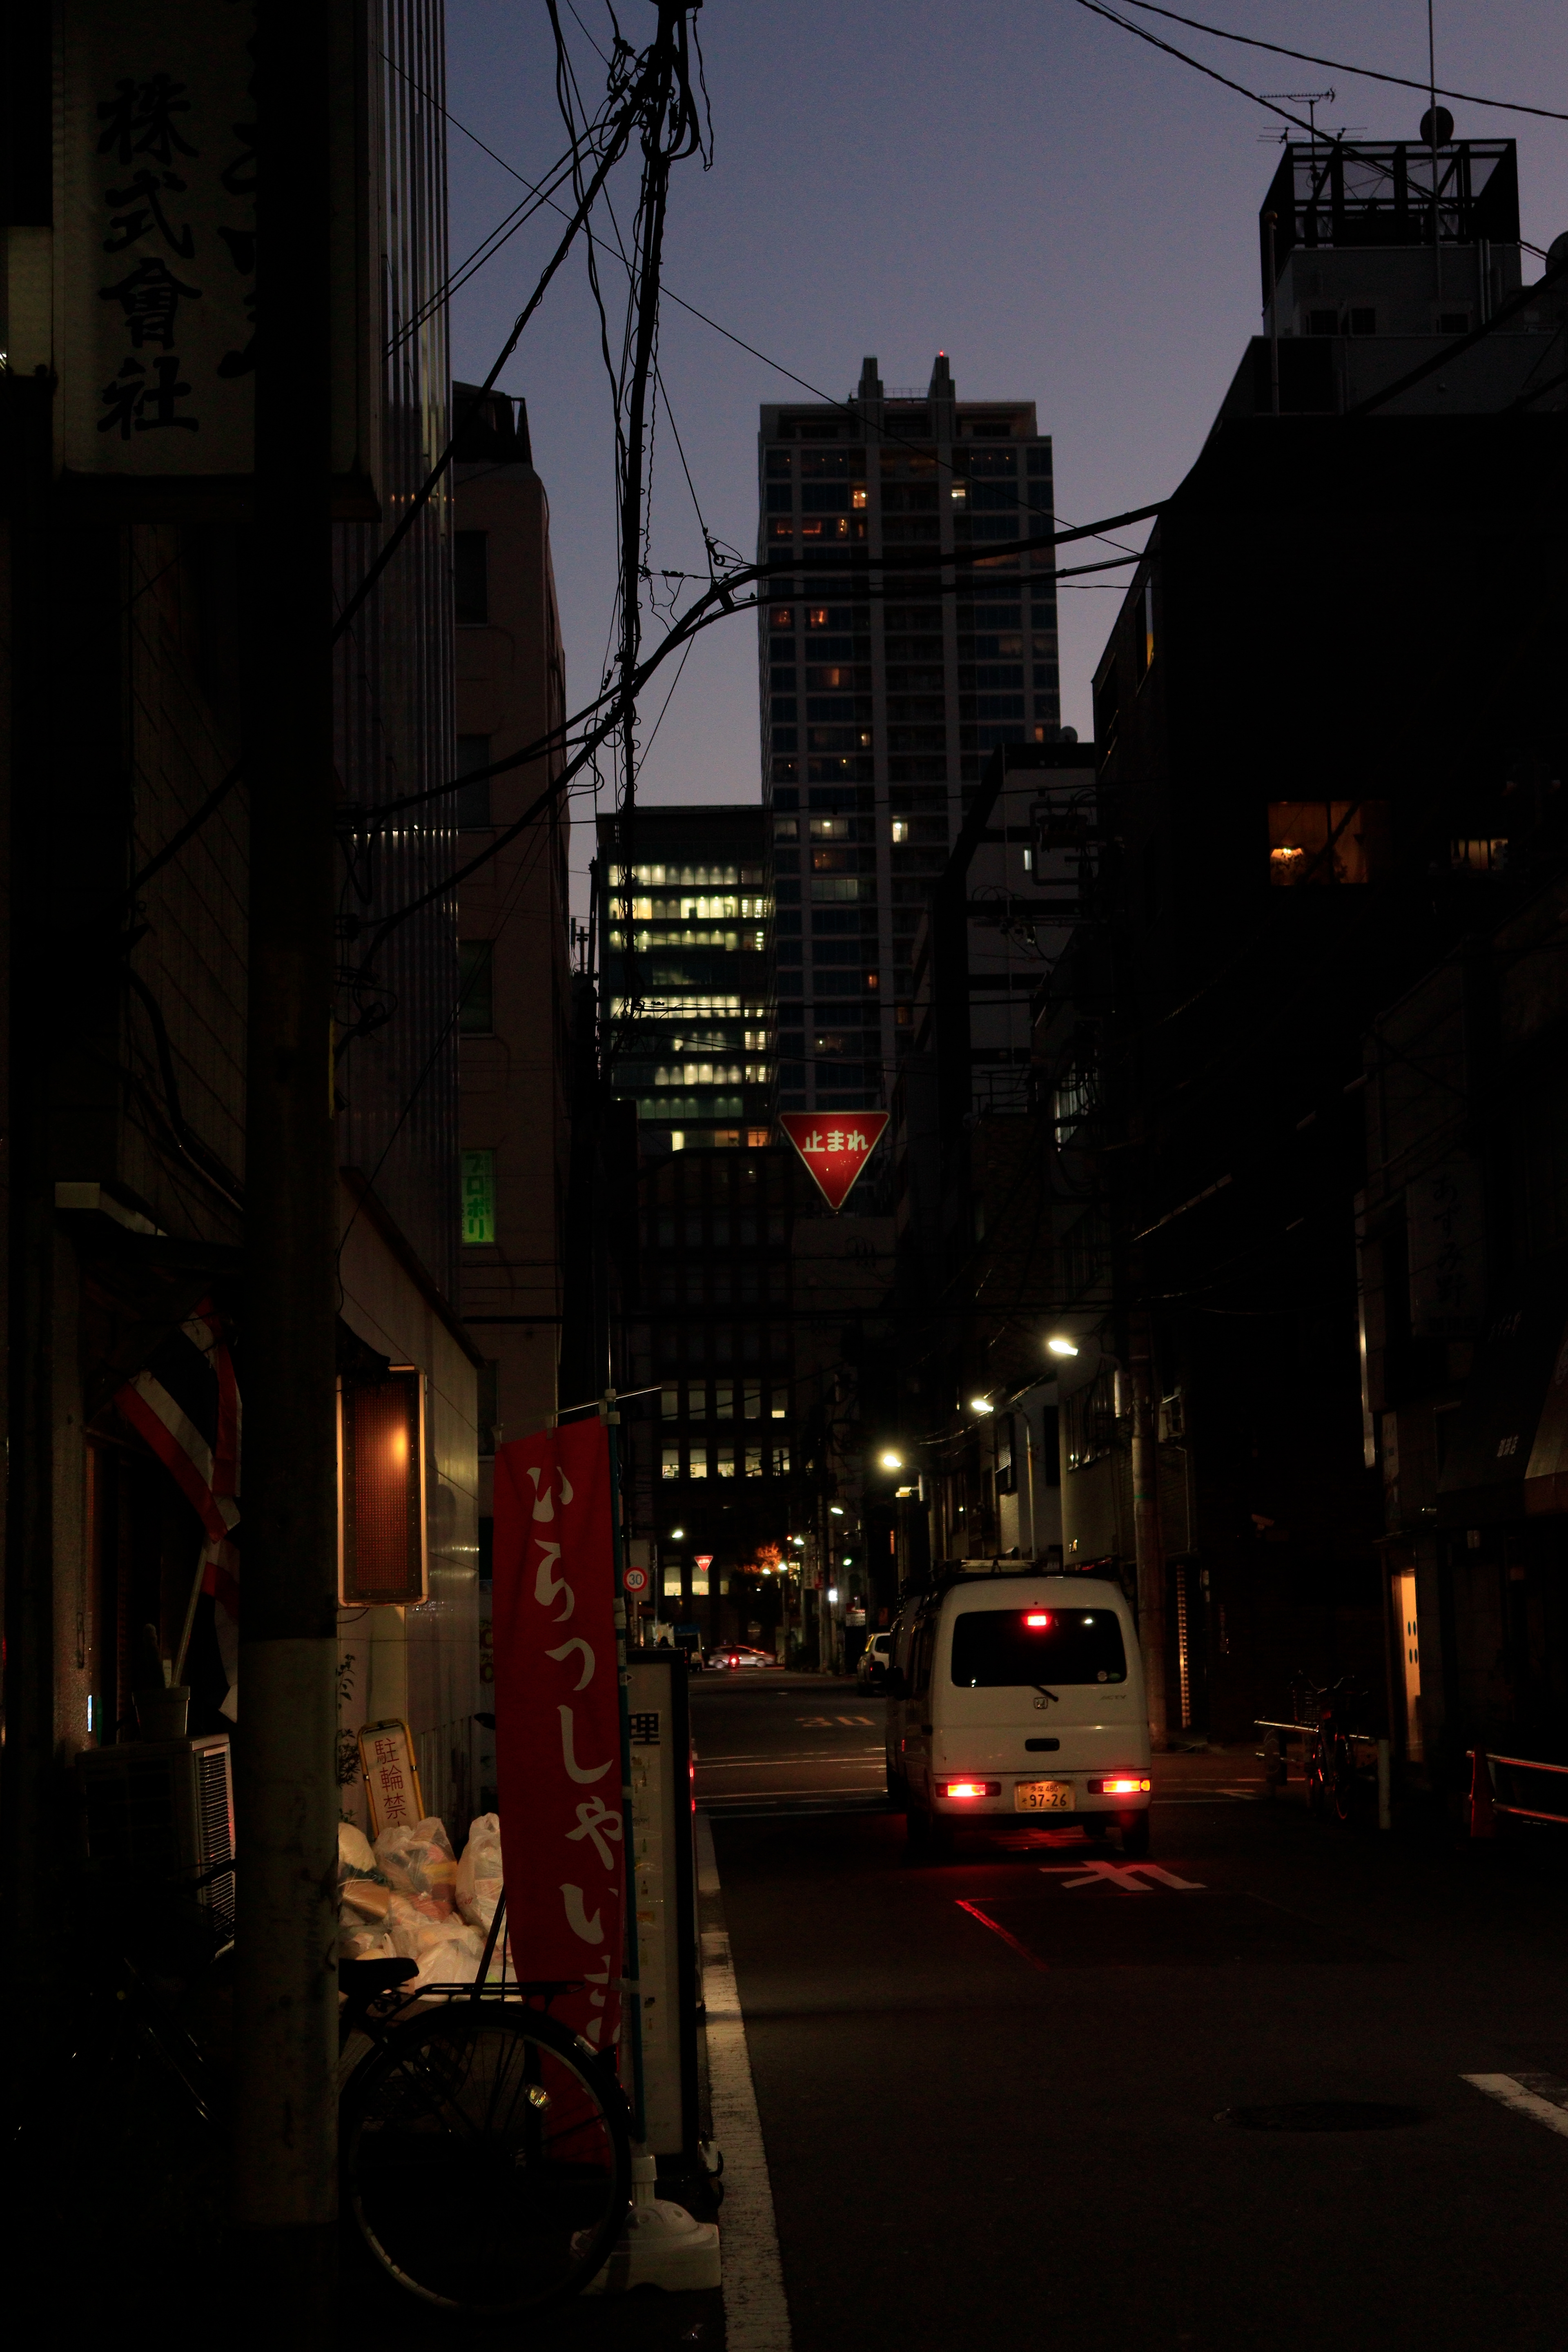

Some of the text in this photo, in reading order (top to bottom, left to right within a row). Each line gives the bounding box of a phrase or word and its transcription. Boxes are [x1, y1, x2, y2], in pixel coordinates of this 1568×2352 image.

[97, 74, 202, 439] 株式會社
[803, 1130, 869, 1152] 止まれ
[629, 1574, 642, 1585] 30
[375, 1738, 406, 1827] 駐輪禁
[1030, 1794, 1066, 1807] 97-26
